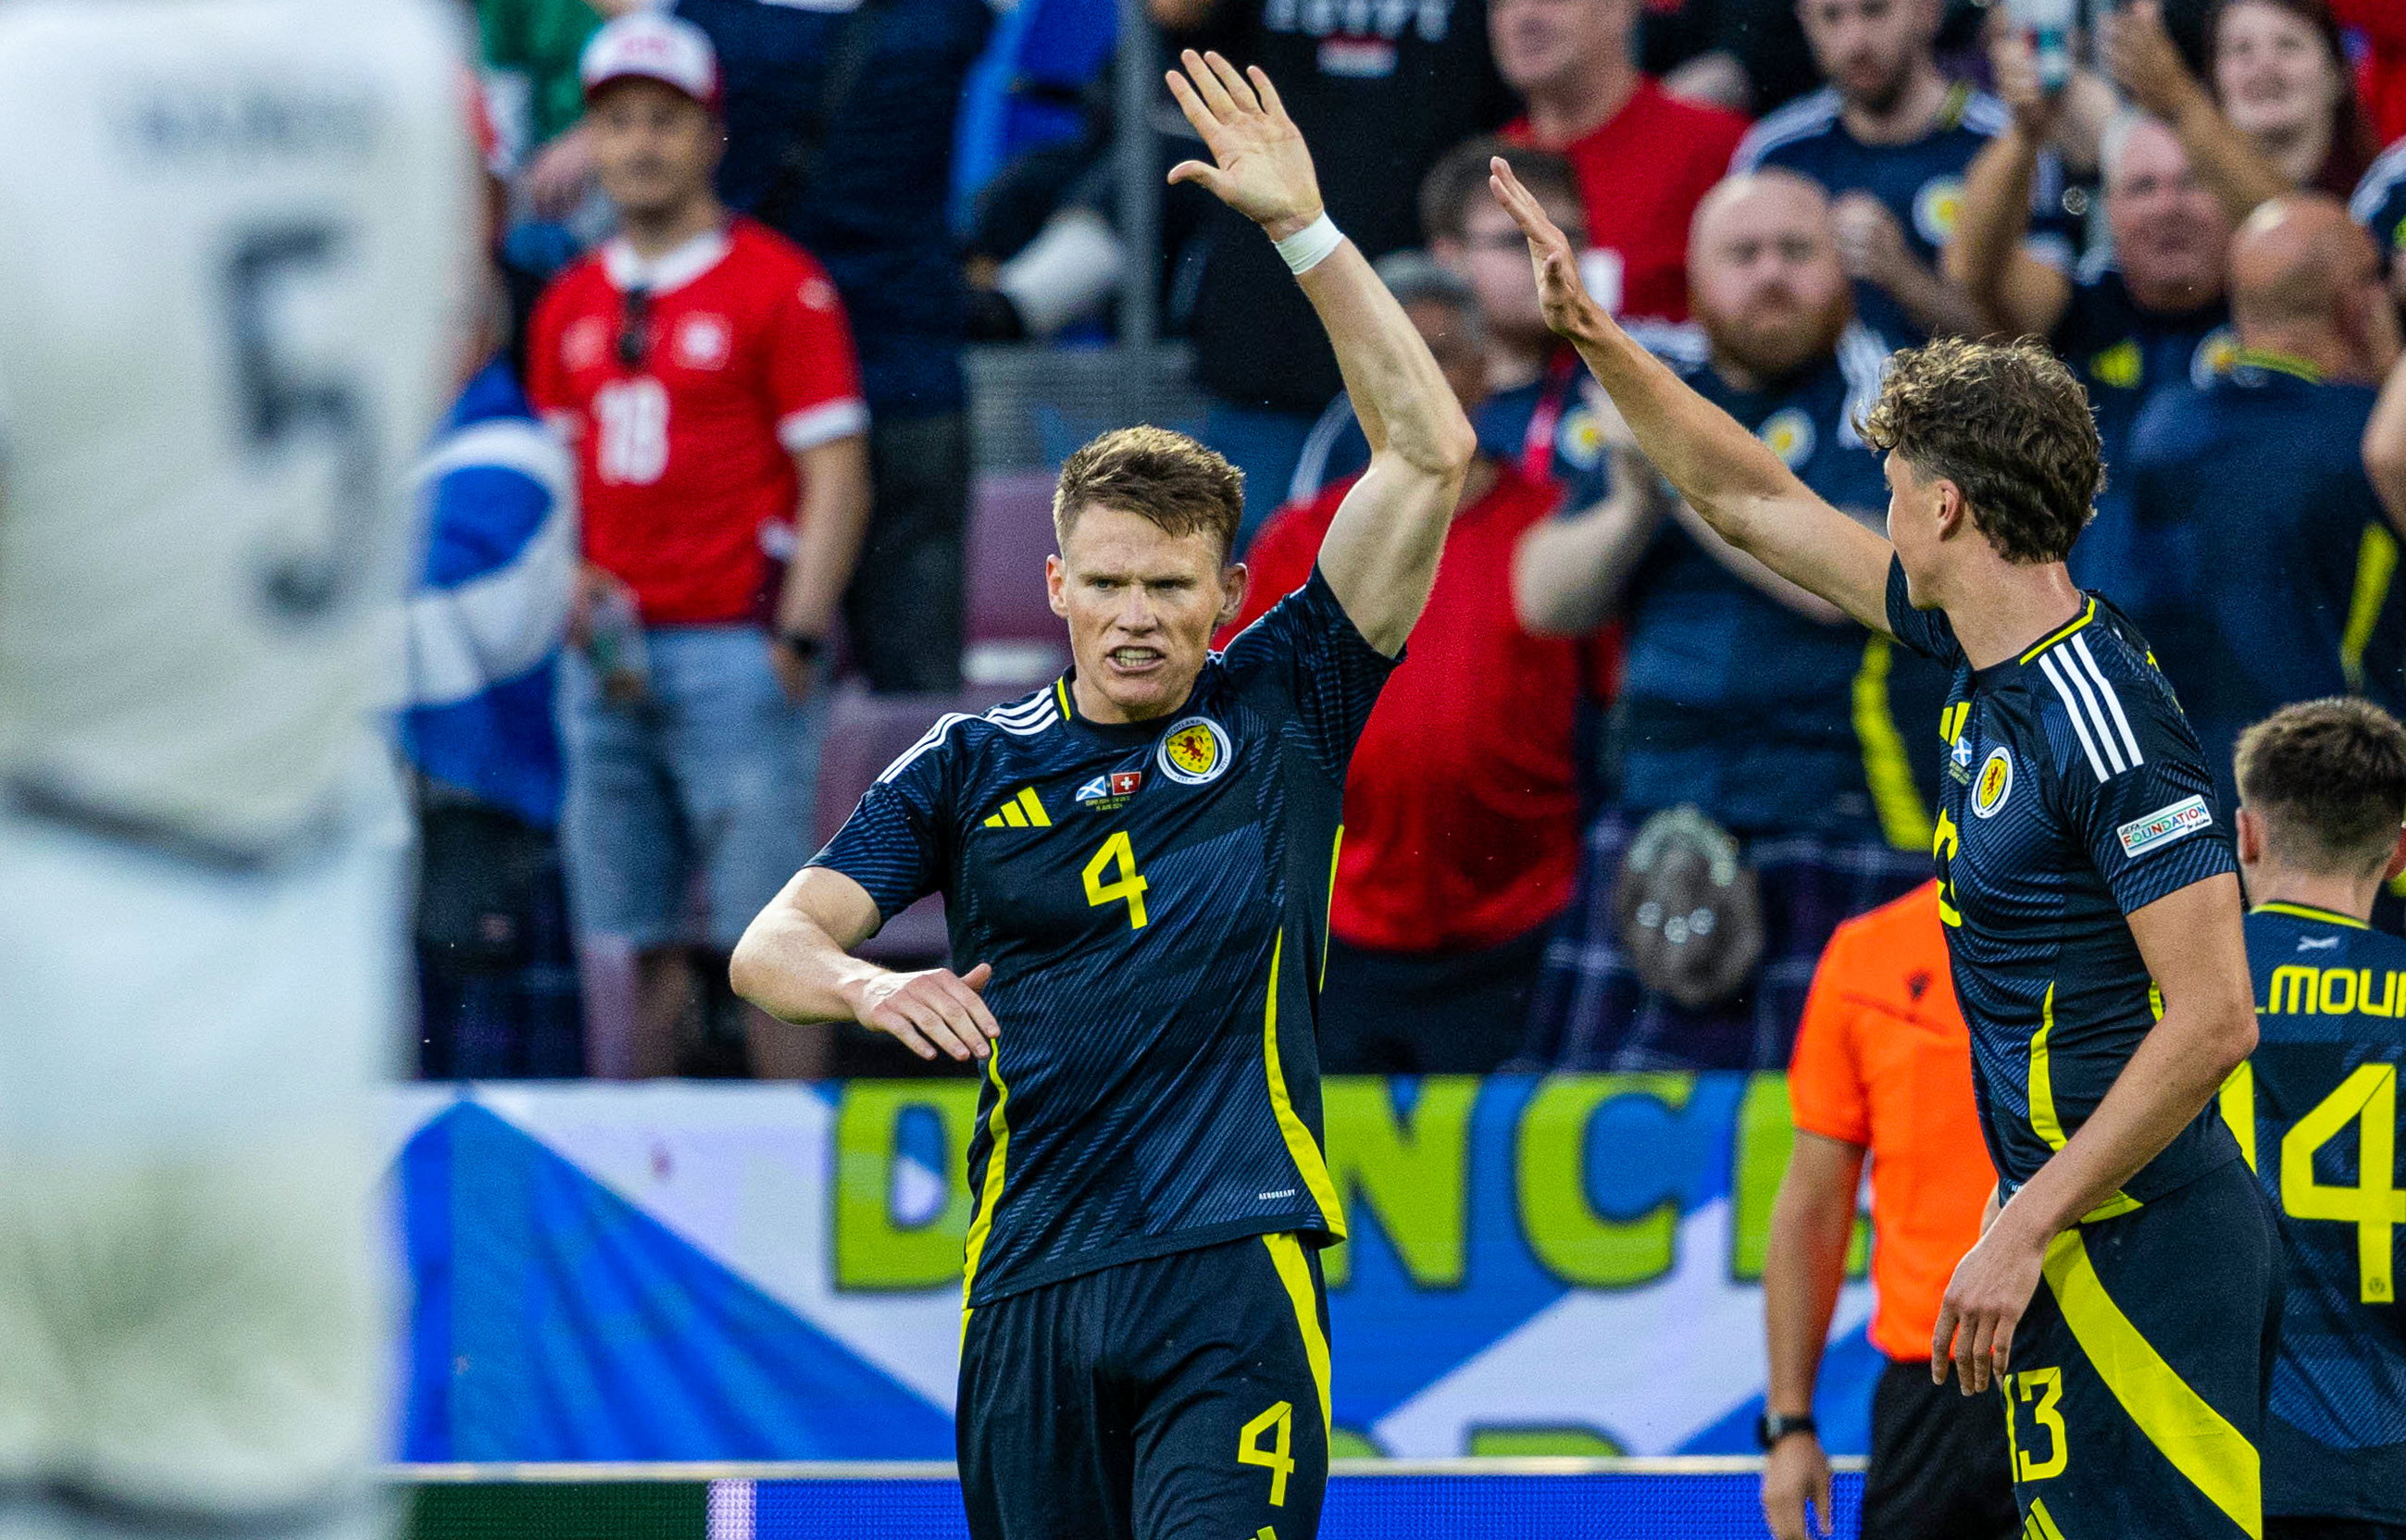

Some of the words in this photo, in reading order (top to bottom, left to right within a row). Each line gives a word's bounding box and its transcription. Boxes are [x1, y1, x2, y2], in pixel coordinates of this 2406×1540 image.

[218, 217, 378, 622] 5
[2123, 804, 2207, 847] FOUNDATION
[1081, 830, 1149, 930] 4
[2254, 964, 2406, 1018] MOU
[1238, 1400, 1295, 1507] 4
